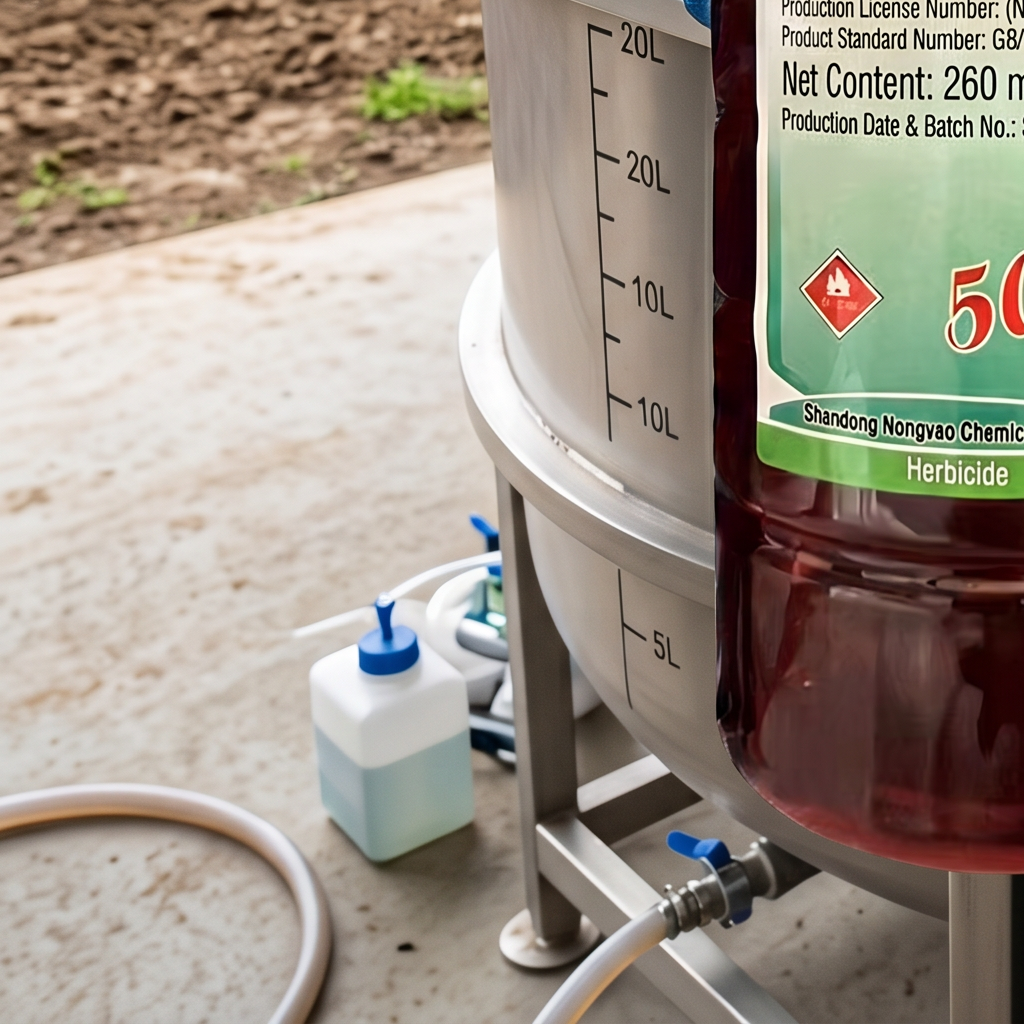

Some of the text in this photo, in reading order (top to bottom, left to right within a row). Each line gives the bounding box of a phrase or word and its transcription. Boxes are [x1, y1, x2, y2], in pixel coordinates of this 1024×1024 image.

[621, 21, 665, 64] 20L
[781, 25, 833, 48] Product
[838, 27, 907, 50] Standard
[913, 28, 986, 50] Number:
[783, 60, 819, 97] Net
[826, 62, 933, 100] Content:
[944, 65, 997, 100] 260
[781, 107, 858, 135] Production
[863, 112, 900, 137] Date
[905, 114, 919, 137] &
[924, 114, 974, 138] Batch
[980, 114, 1016, 138] No.:
[626, 150, 671, 194] 20L
[632, 275, 675, 320] 10L
[637, 396, 679, 441] 10L
[804, 402, 878, 437] Shandong
[907, 455, 1009, 486] Herbicide
[653, 629, 681, 670] 5L
